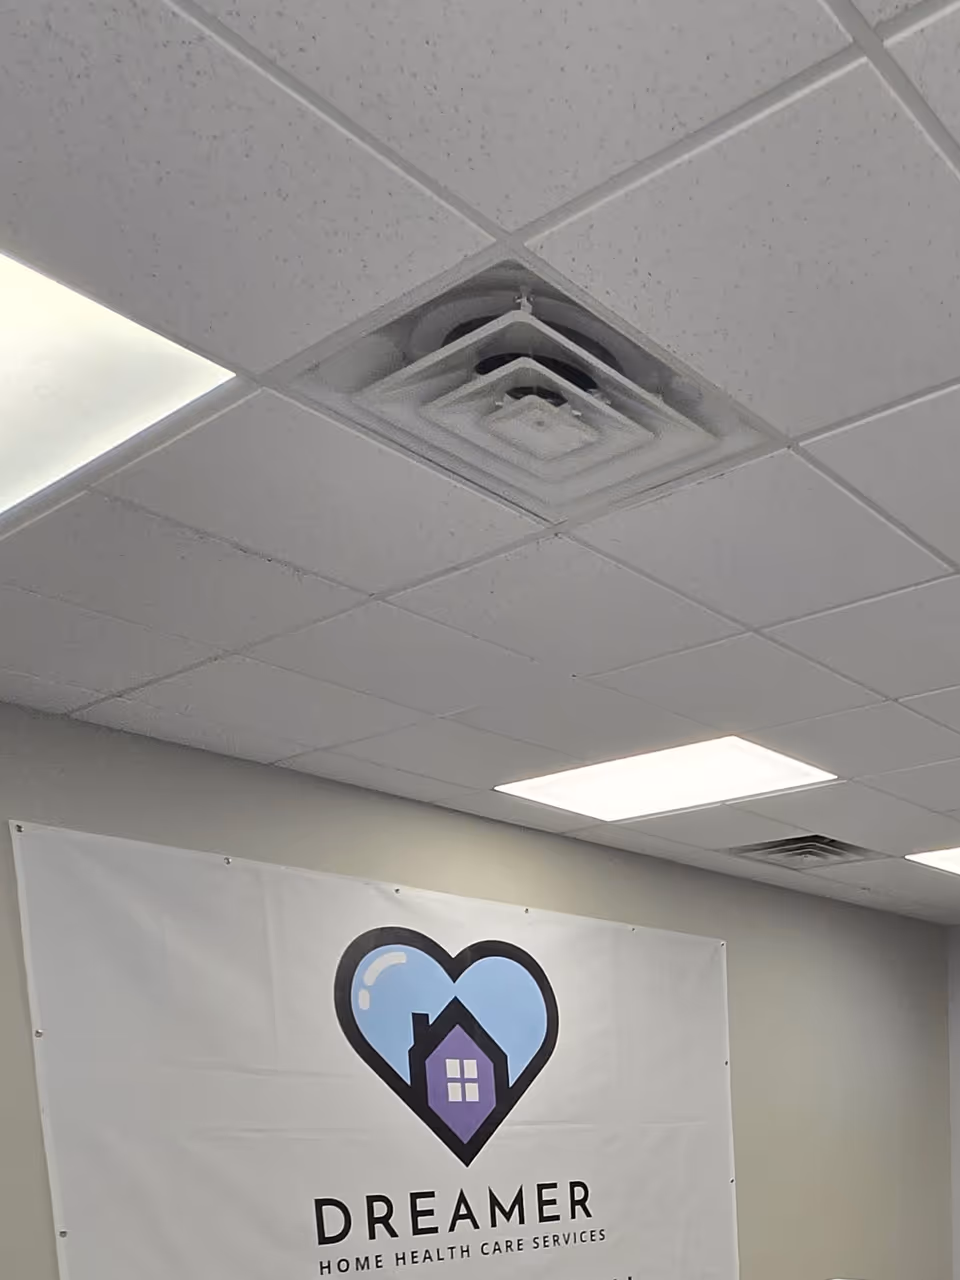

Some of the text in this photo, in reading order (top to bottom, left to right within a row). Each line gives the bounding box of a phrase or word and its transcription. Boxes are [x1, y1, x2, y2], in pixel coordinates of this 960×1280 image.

[313, 1181, 593, 1246] DREAMER
[319, 1229, 606, 1275] HOME HEALTH CARE SERVICES
